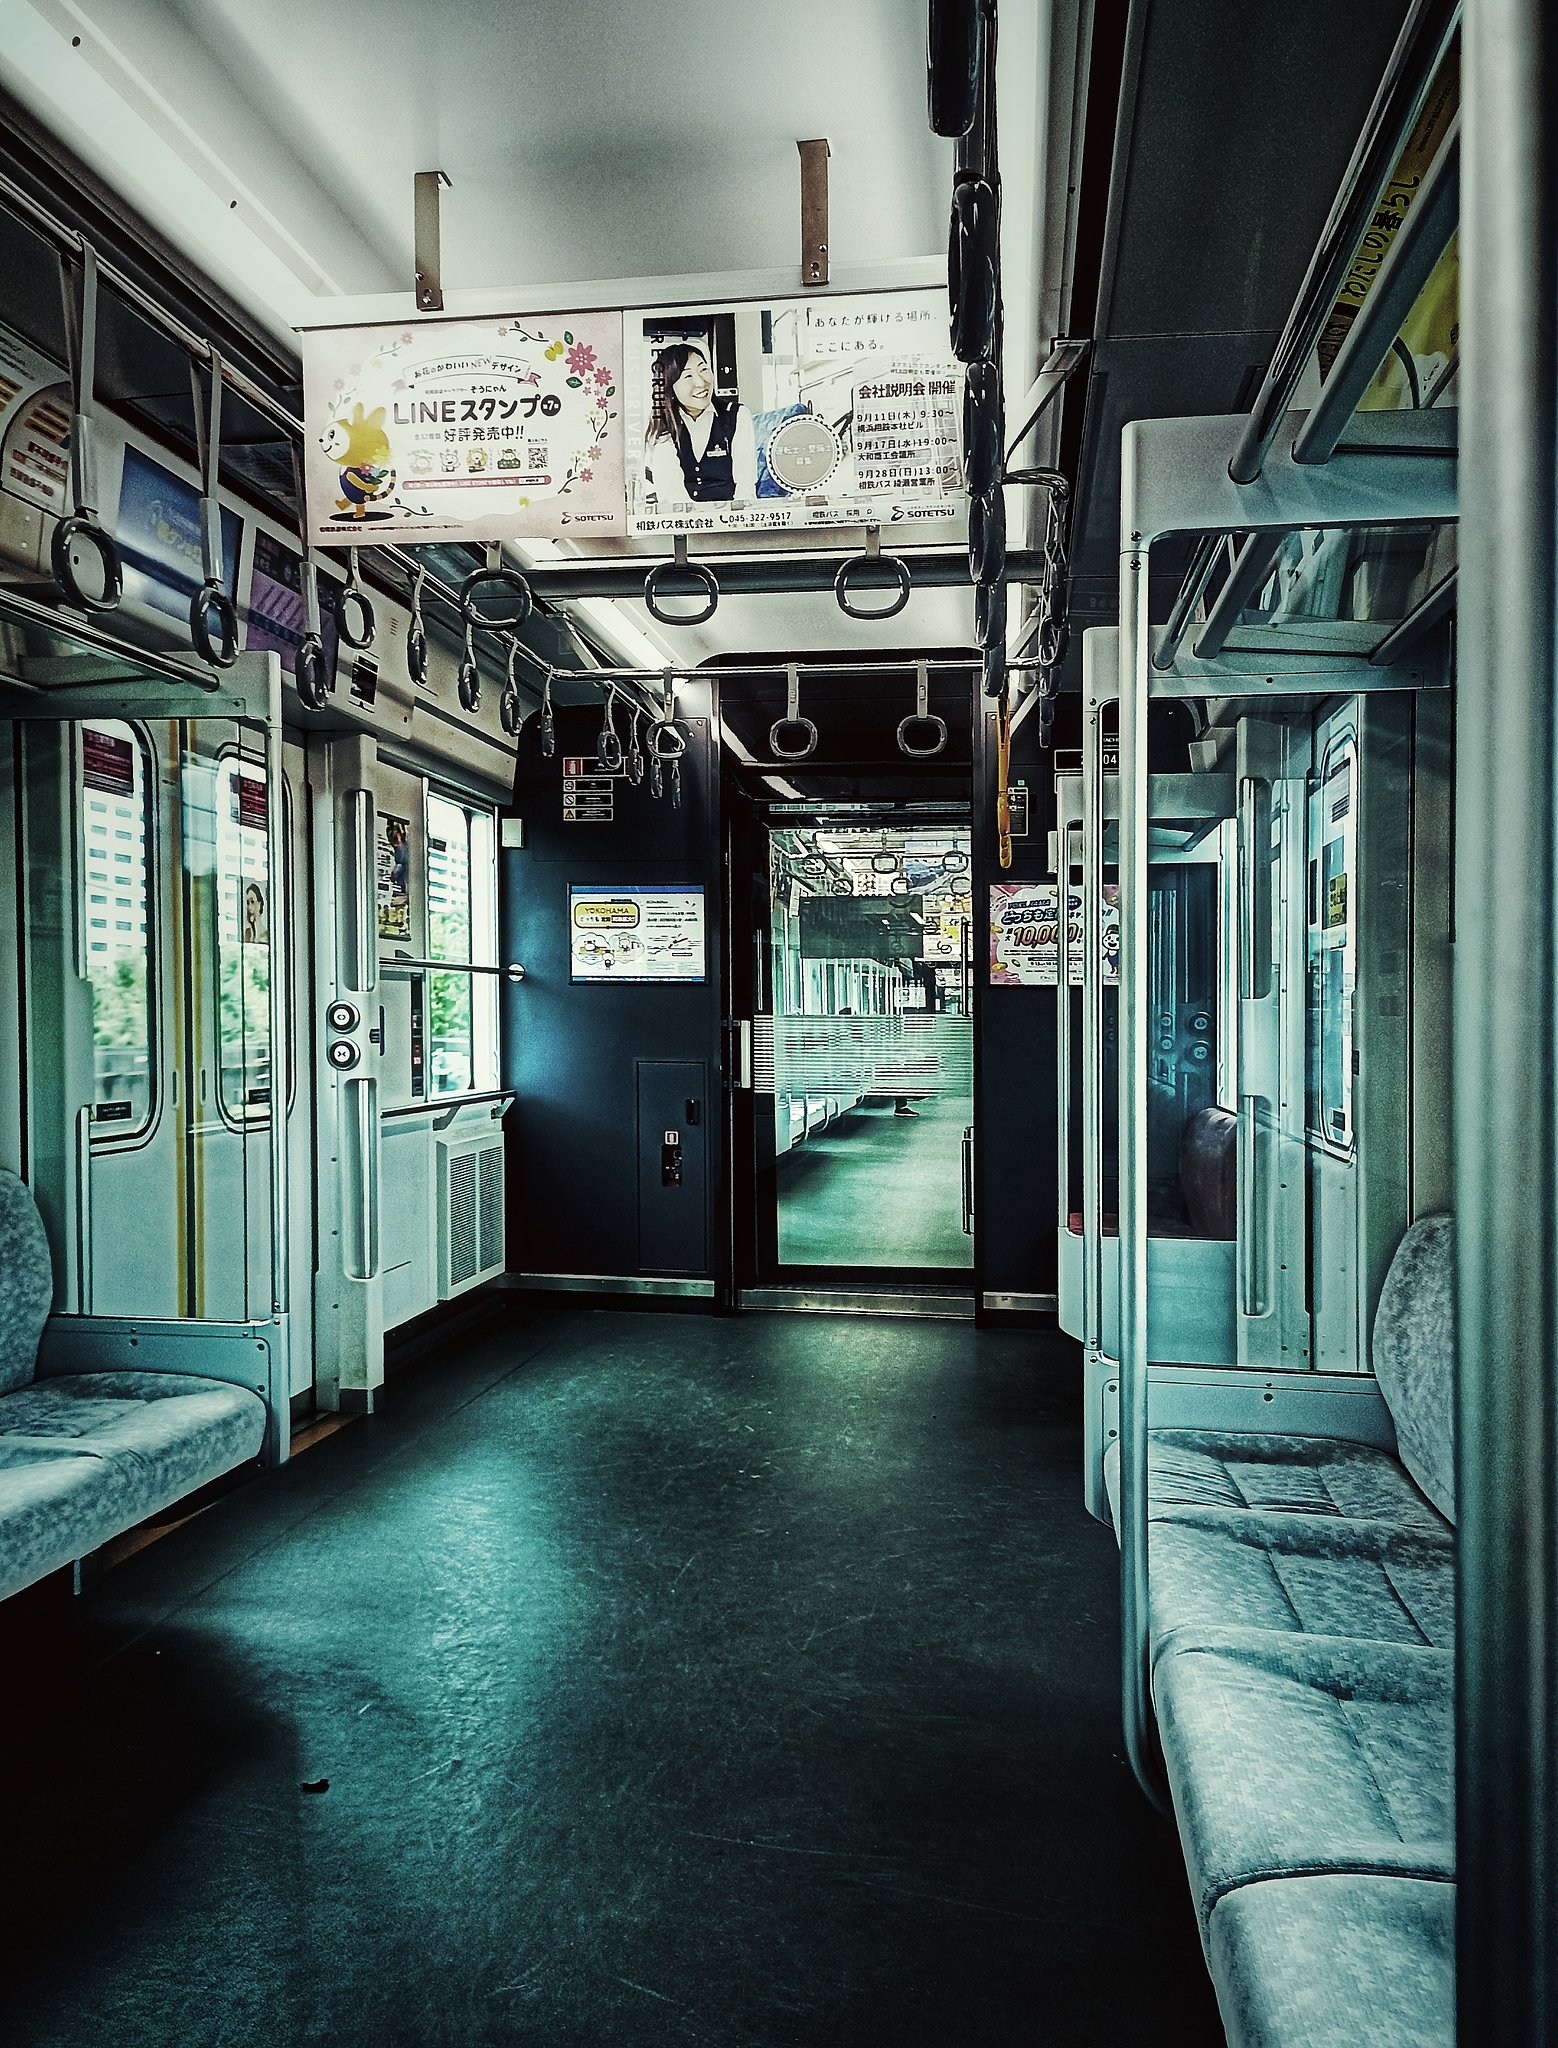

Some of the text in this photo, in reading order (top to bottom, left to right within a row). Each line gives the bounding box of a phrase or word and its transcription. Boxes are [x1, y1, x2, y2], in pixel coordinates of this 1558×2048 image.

[815, 339, 885, 353] ここにある。
[470, 384, 508, 394] そうにゃん
[858, 380, 956, 399] 会社説明会 開催
[574, 514, 615, 522] SOTETSU
[728, 511, 792, 523] 045-322-9517
[907, 508, 955, 518] SOTETSU
[584, 907, 630, 915] YOKOHAMA
[1002, 908, 1058, 924] どっちも定
